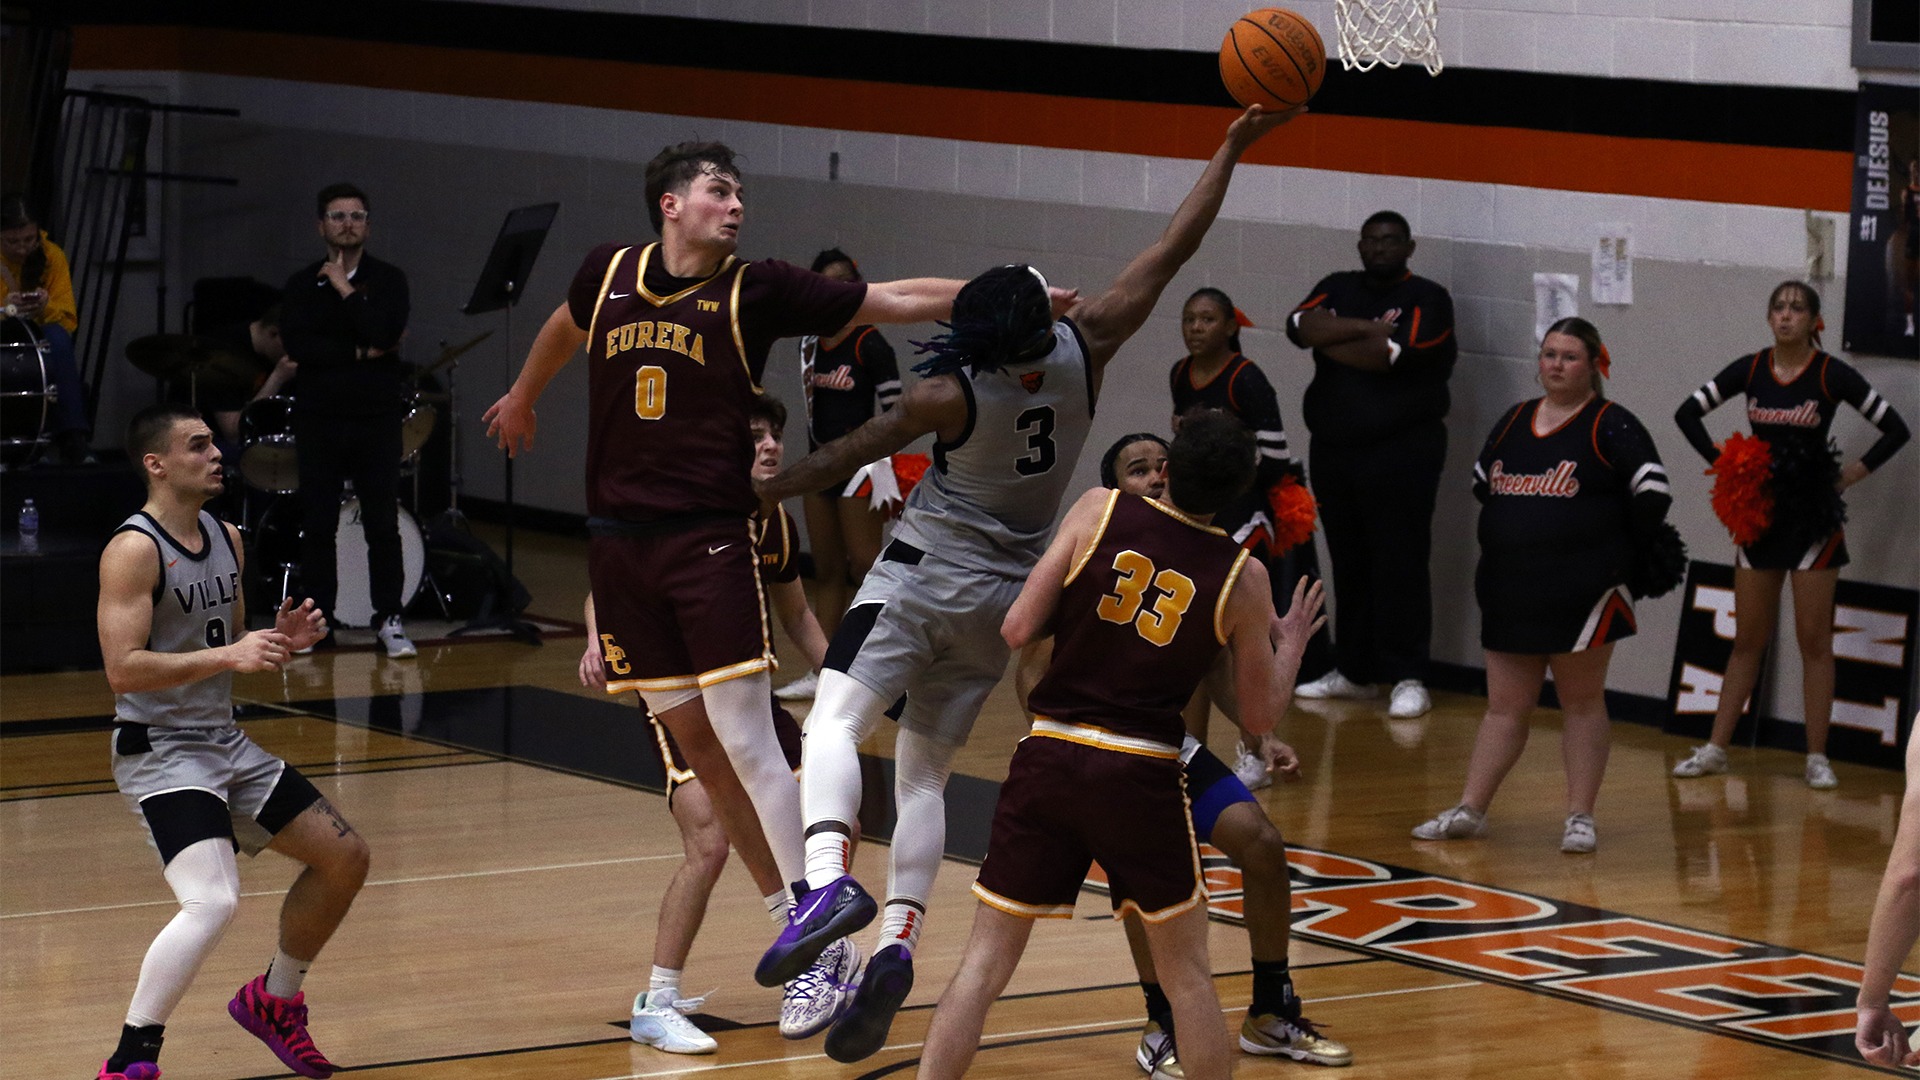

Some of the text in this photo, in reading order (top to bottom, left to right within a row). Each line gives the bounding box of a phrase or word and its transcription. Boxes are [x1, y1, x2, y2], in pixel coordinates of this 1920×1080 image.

[1866, 110, 1889, 210] DEJESUS
[1860, 215, 1877, 241] #1
[697, 299, 720, 313] TWW
[606, 321, 705, 366] EUREKA
[635, 365, 667, 420] 0
[1014, 404, 1057, 478] 3
[173, 572, 238, 614] VILLE
[1096, 549, 1196, 647] 33
[600, 633, 631, 675] EC
[1083, 838, 1920, 1069] REE
